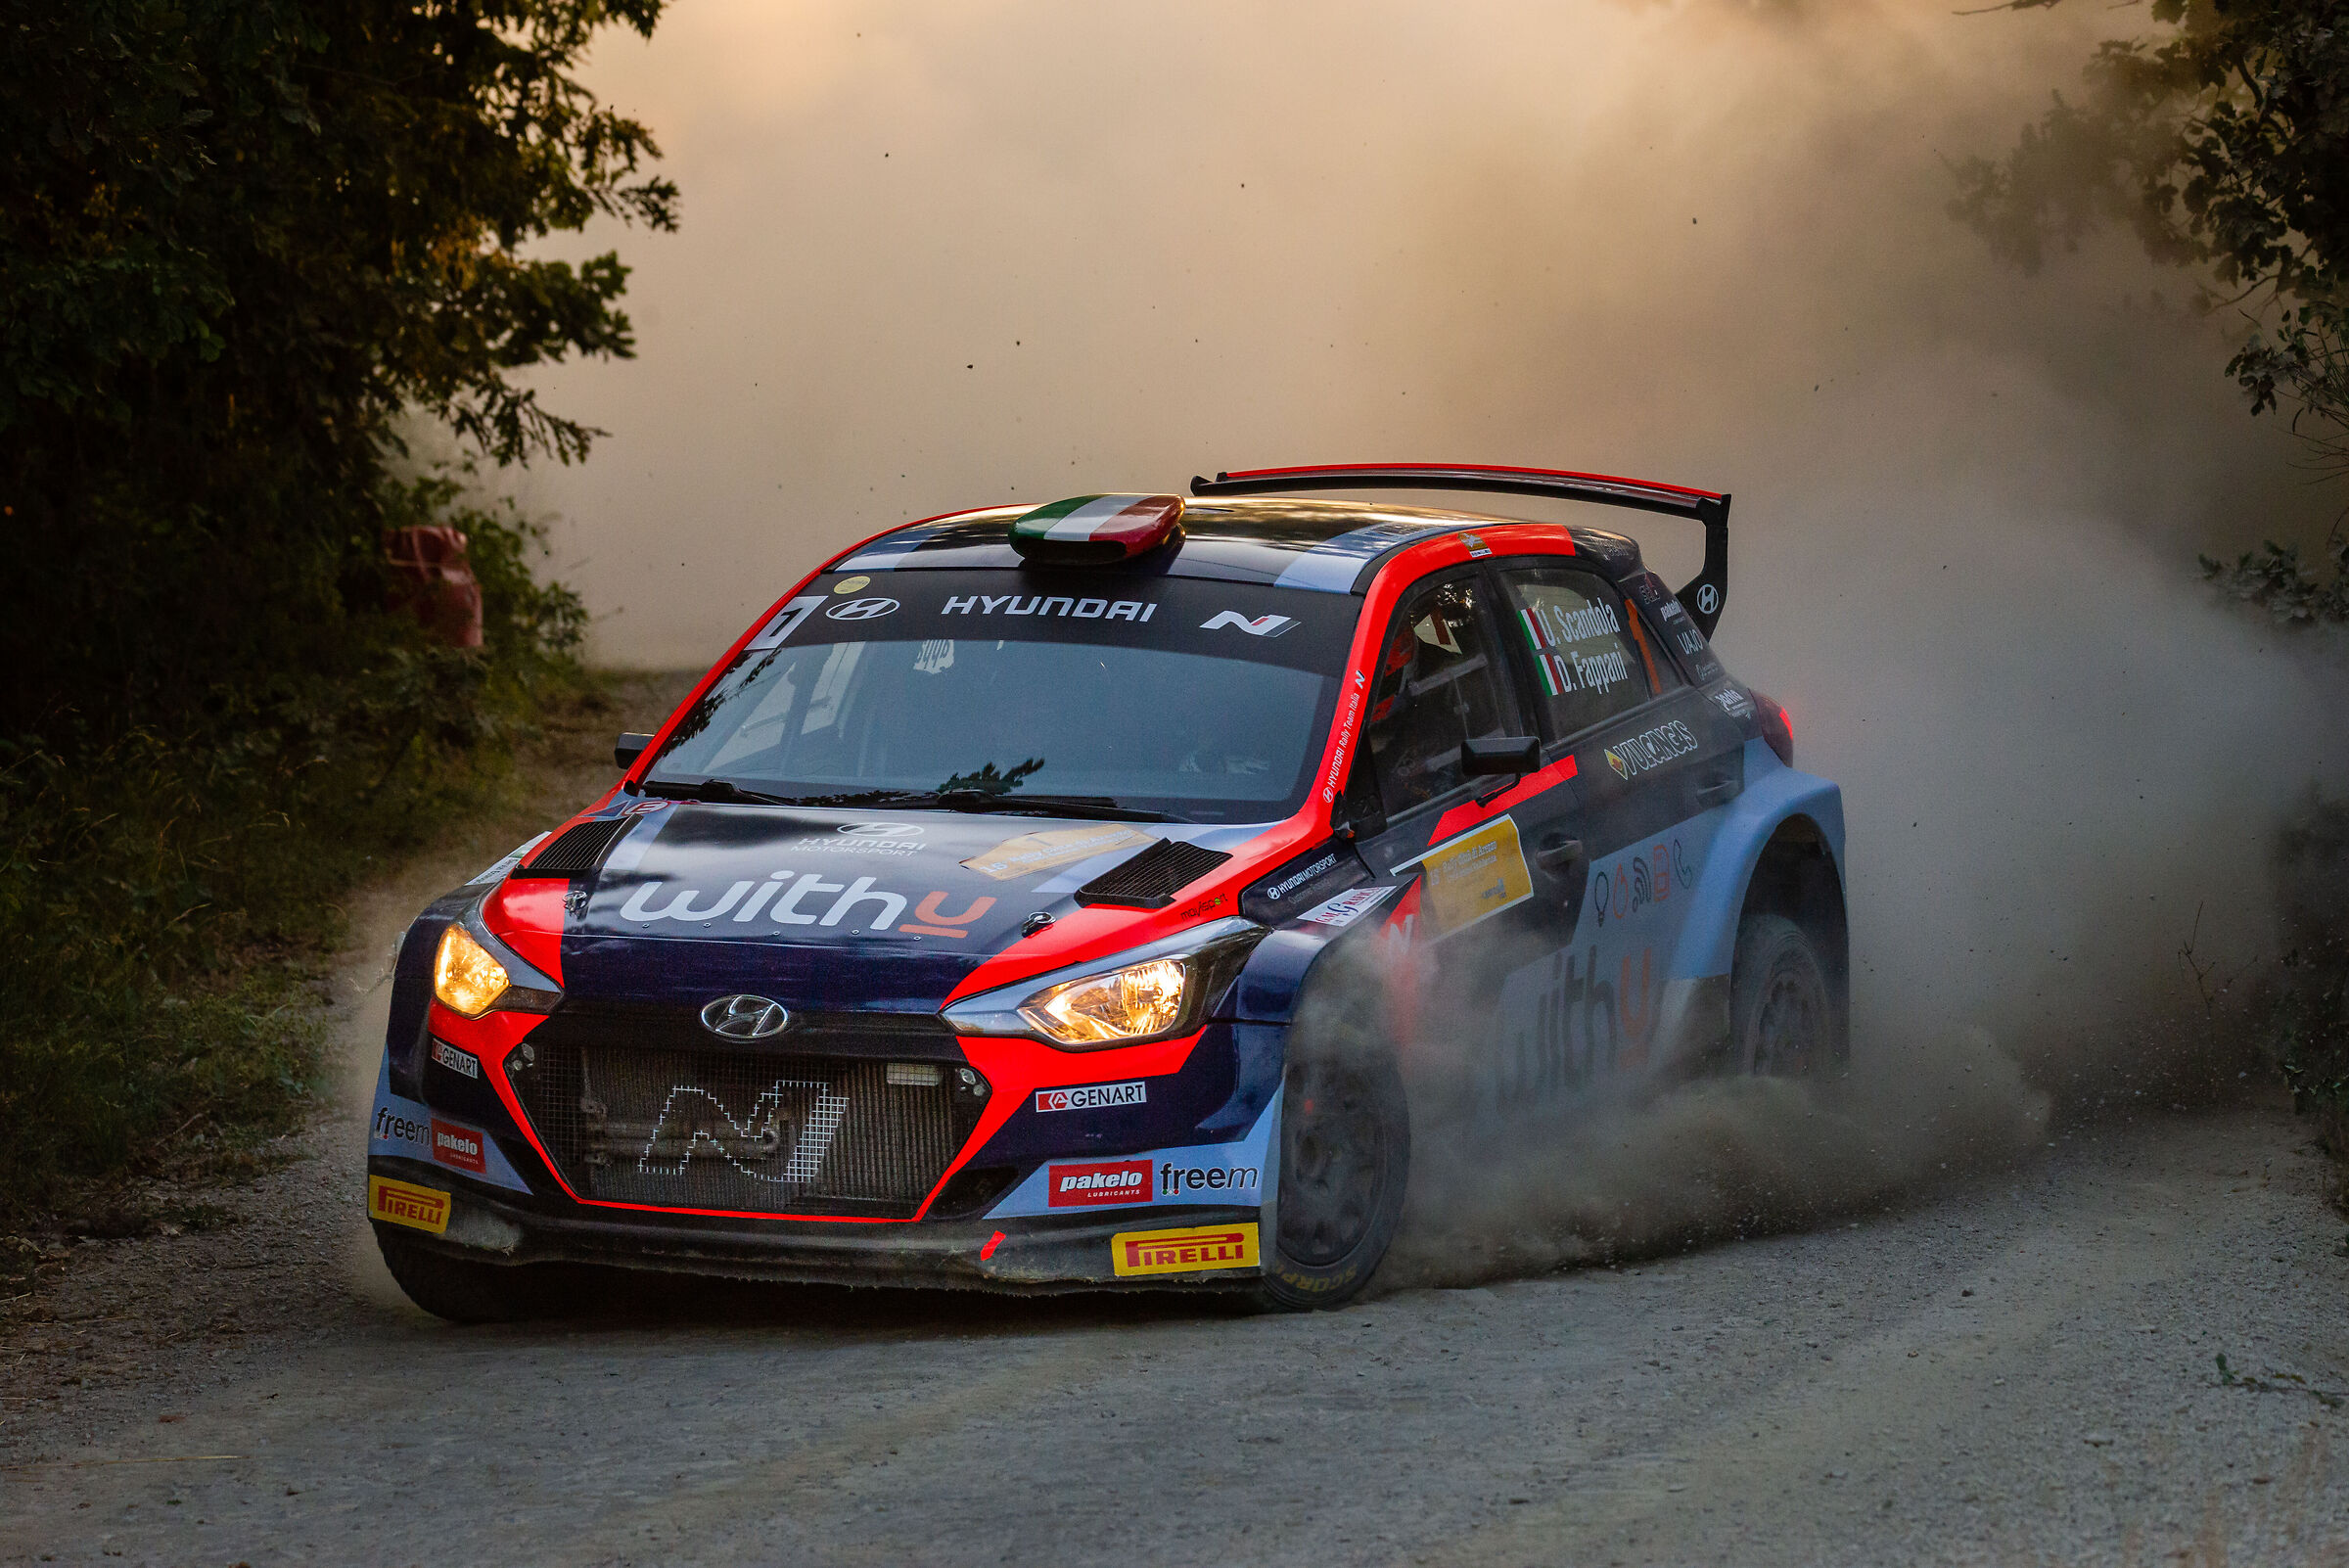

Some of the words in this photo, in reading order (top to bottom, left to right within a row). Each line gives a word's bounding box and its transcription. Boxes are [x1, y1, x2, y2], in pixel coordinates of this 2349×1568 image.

[941, 595, 1158, 623] HYUNDAI
[1535, 608, 1562, 647] U.
[1553, 596, 1621, 643] Scandola
[1552, 654, 1578, 693] D.
[1570, 642, 1629, 695] Fappani
[1349, 692, 1360, 712] Italia
[1343, 709, 1356, 729] Team
[1339, 728, 1351, 749] Rally
[1612, 719, 1698, 776] VULCANGAS
[1327, 747, 1345, 788] HYUNDAI
[790, 846, 919, 857] MOTORSPORT
[797, 838, 928, 851] HYUNDAI
[1277, 871, 1306, 894] HYUNDAI
[1302, 853, 1338, 880] MOTORSPORT
[619, 870, 998, 938] withu
[442, 1047, 477, 1076] GENART
[1071, 1084, 1144, 1108] GENART
[376, 1107, 431, 1146] freem
[437, 1131, 479, 1156] pakelo
[1059, 1170, 1143, 1193] pakelo
[1161, 1162, 1260, 1191] freem
[377, 1184, 445, 1225] PIRELLI
[1087, 1189, 1141, 1198] LUBRICANTS
[1125, 1232, 1245, 1268] PIRELLI
